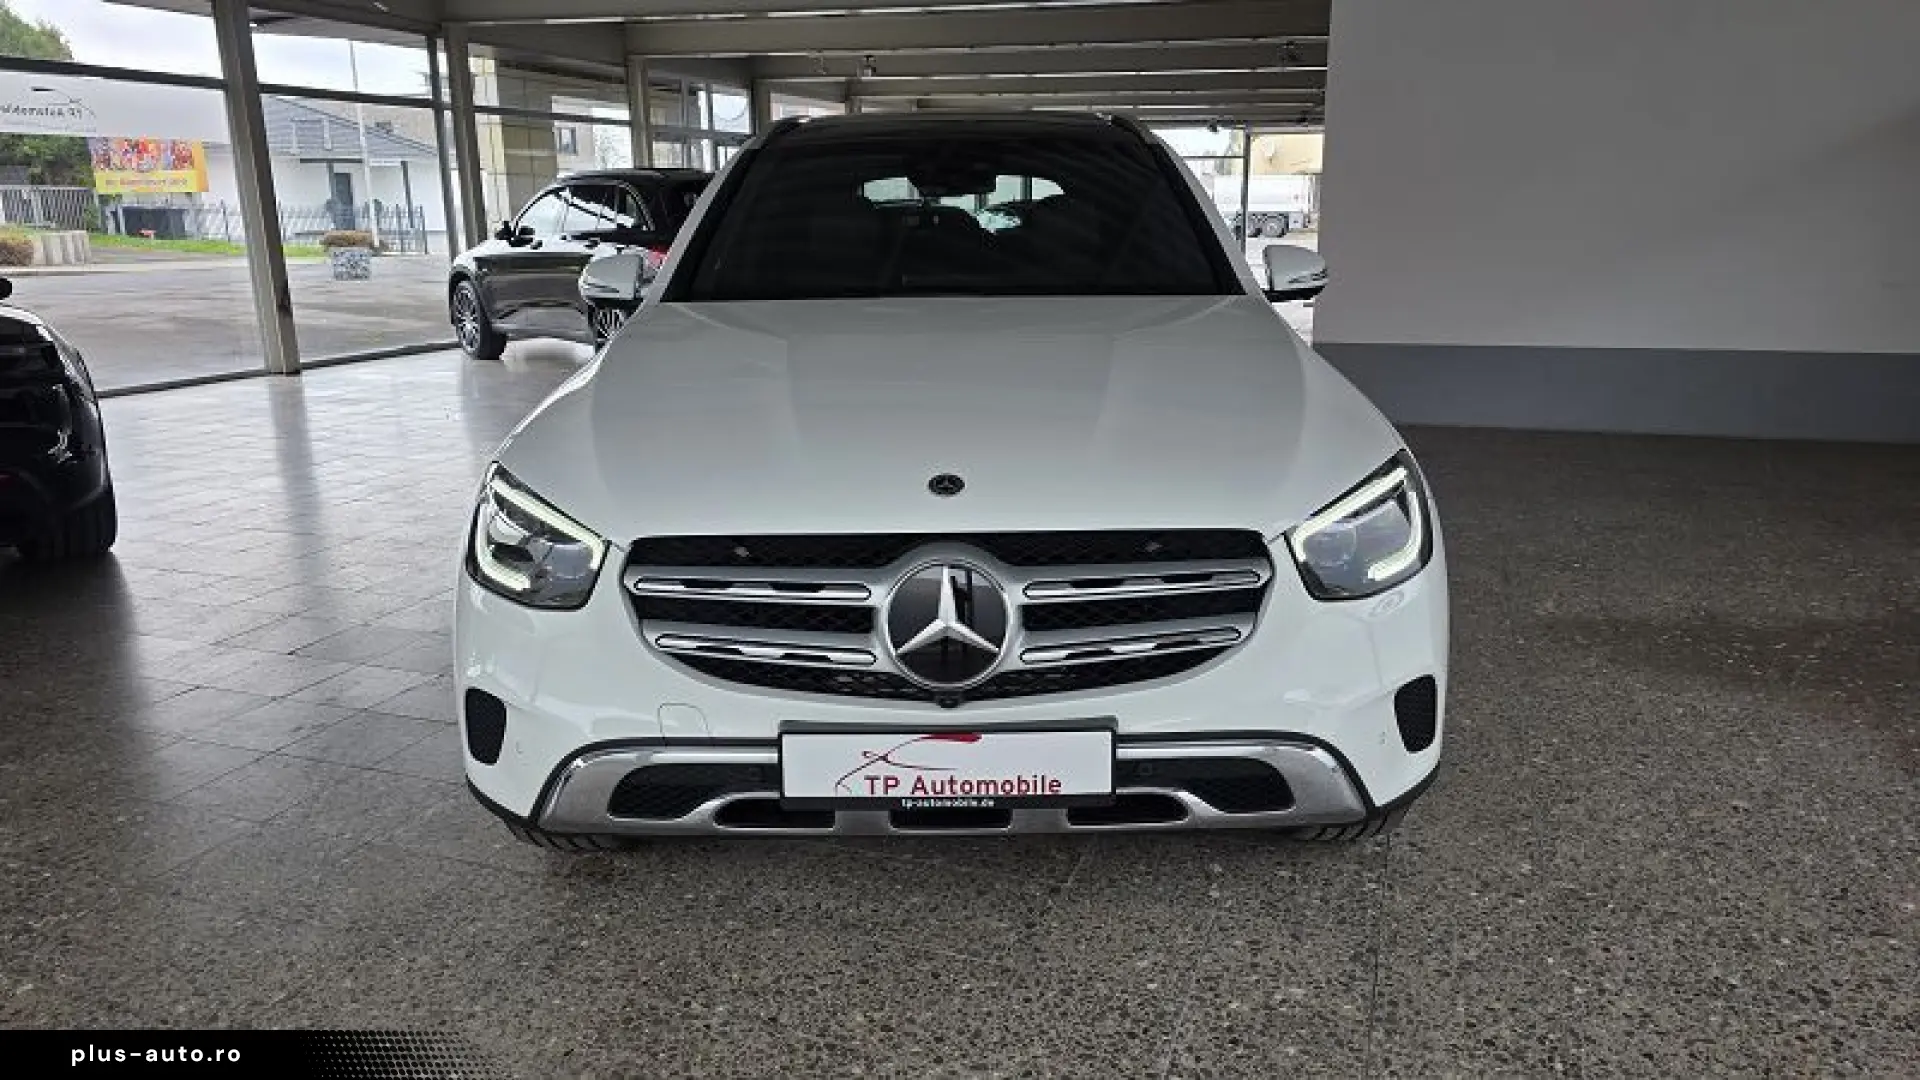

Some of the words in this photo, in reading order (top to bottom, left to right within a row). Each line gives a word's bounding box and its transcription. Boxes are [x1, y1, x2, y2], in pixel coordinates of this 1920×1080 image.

[864, 775, 900, 795] TP
[910, 775, 1062, 795] Automobile
[901, 798, 995, 810] tp-automobile.de
